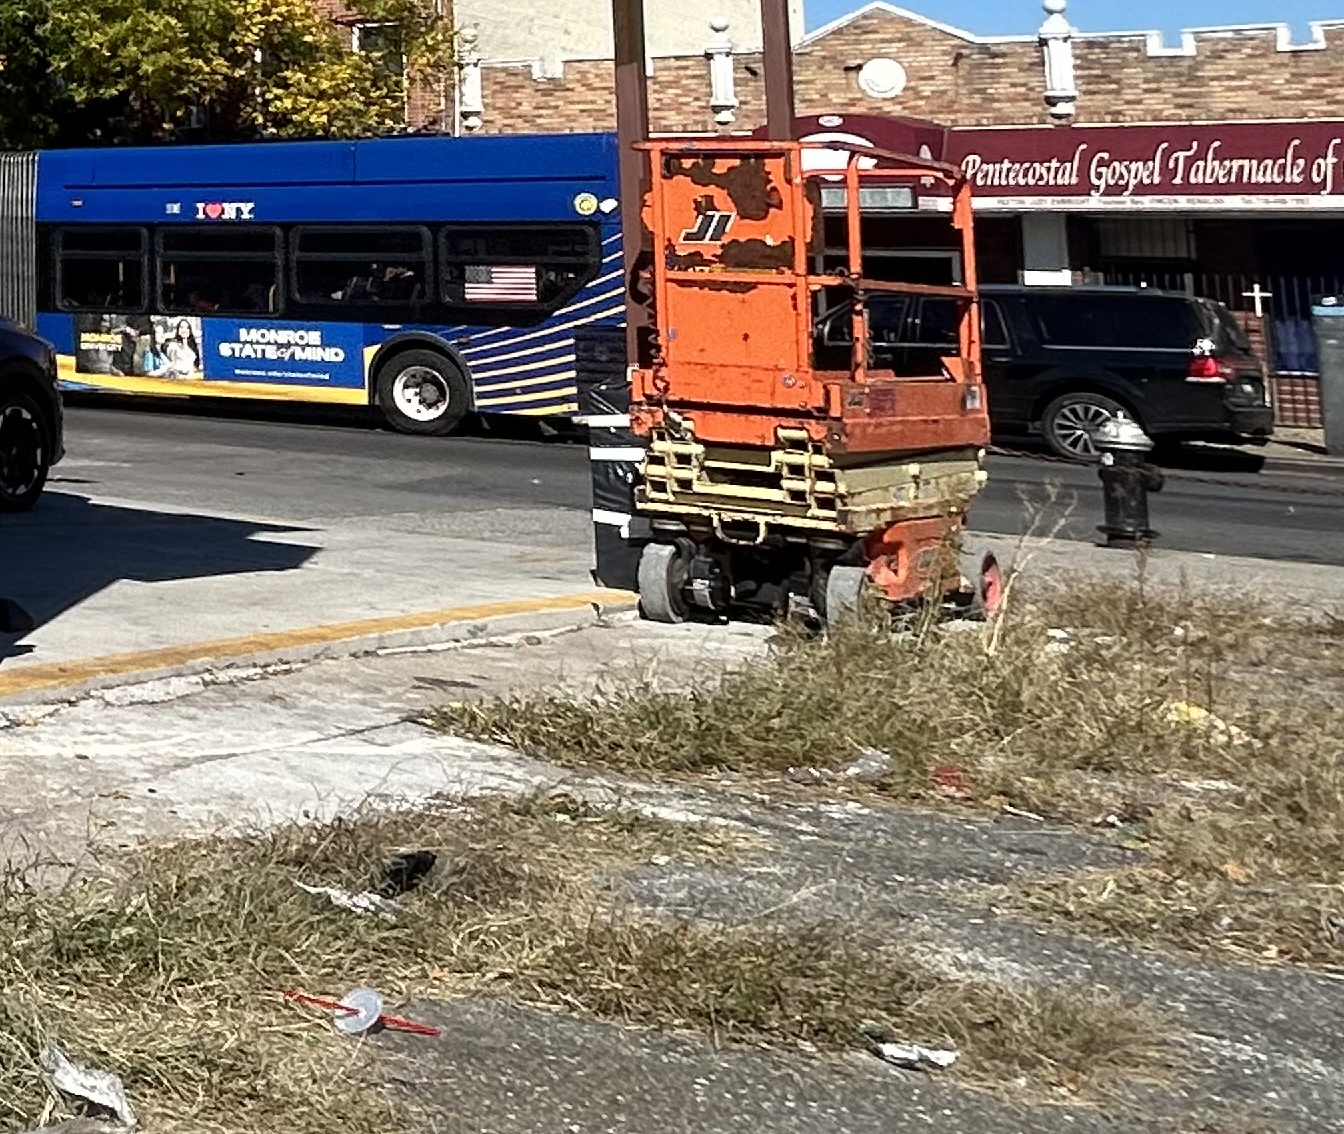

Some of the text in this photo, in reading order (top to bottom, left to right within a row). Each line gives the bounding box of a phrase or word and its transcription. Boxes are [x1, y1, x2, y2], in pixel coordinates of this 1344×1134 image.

[961, 138, 1342, 196] Pentecostal Gospel Tabernacle of
[239, 328, 322, 346] MONROE
[218, 342, 278, 360] STATE
[294, 347, 345, 363] MIND
